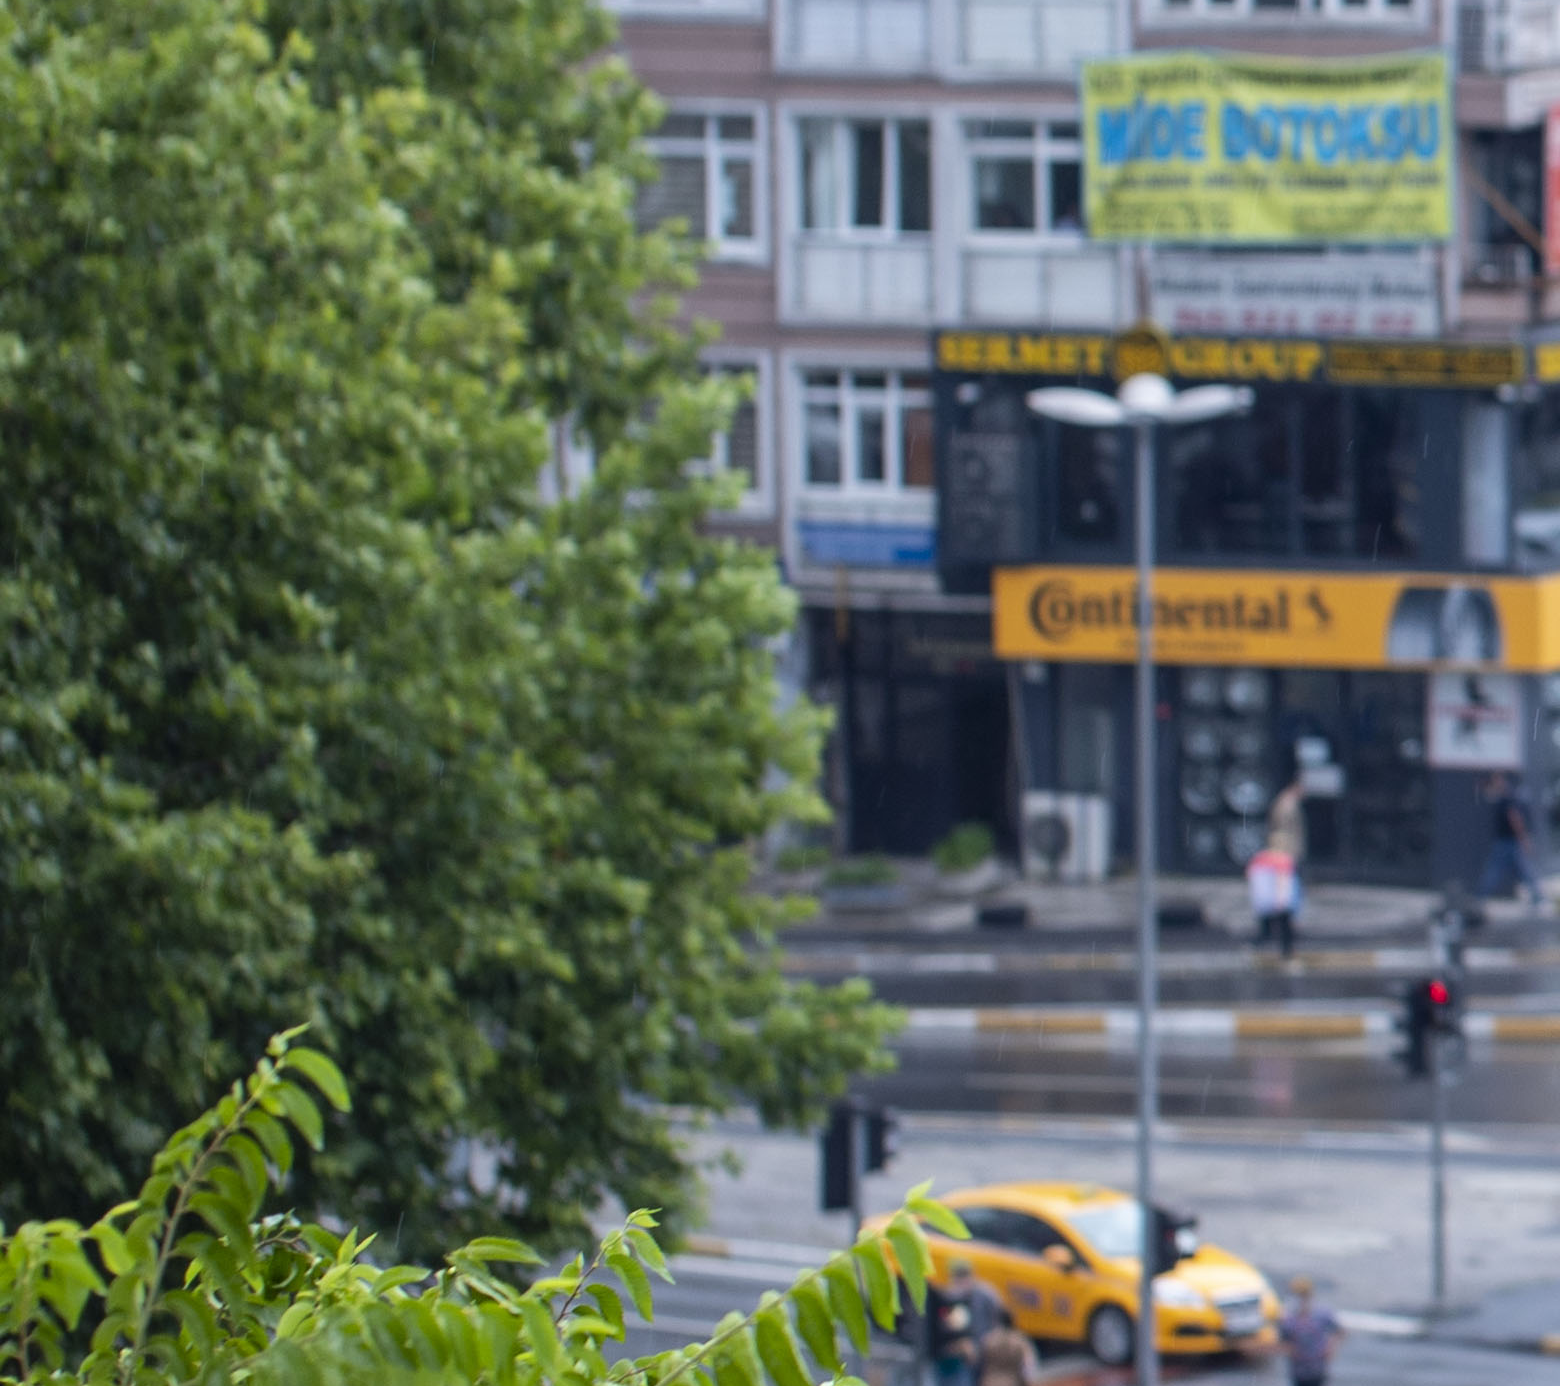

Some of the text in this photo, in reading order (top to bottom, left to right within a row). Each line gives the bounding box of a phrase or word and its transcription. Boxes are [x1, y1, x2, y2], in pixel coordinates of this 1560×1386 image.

[1096, 93, 1441, 166] MİDE BOTOKSU
[1168, 339, 1324, 380] GROUP
